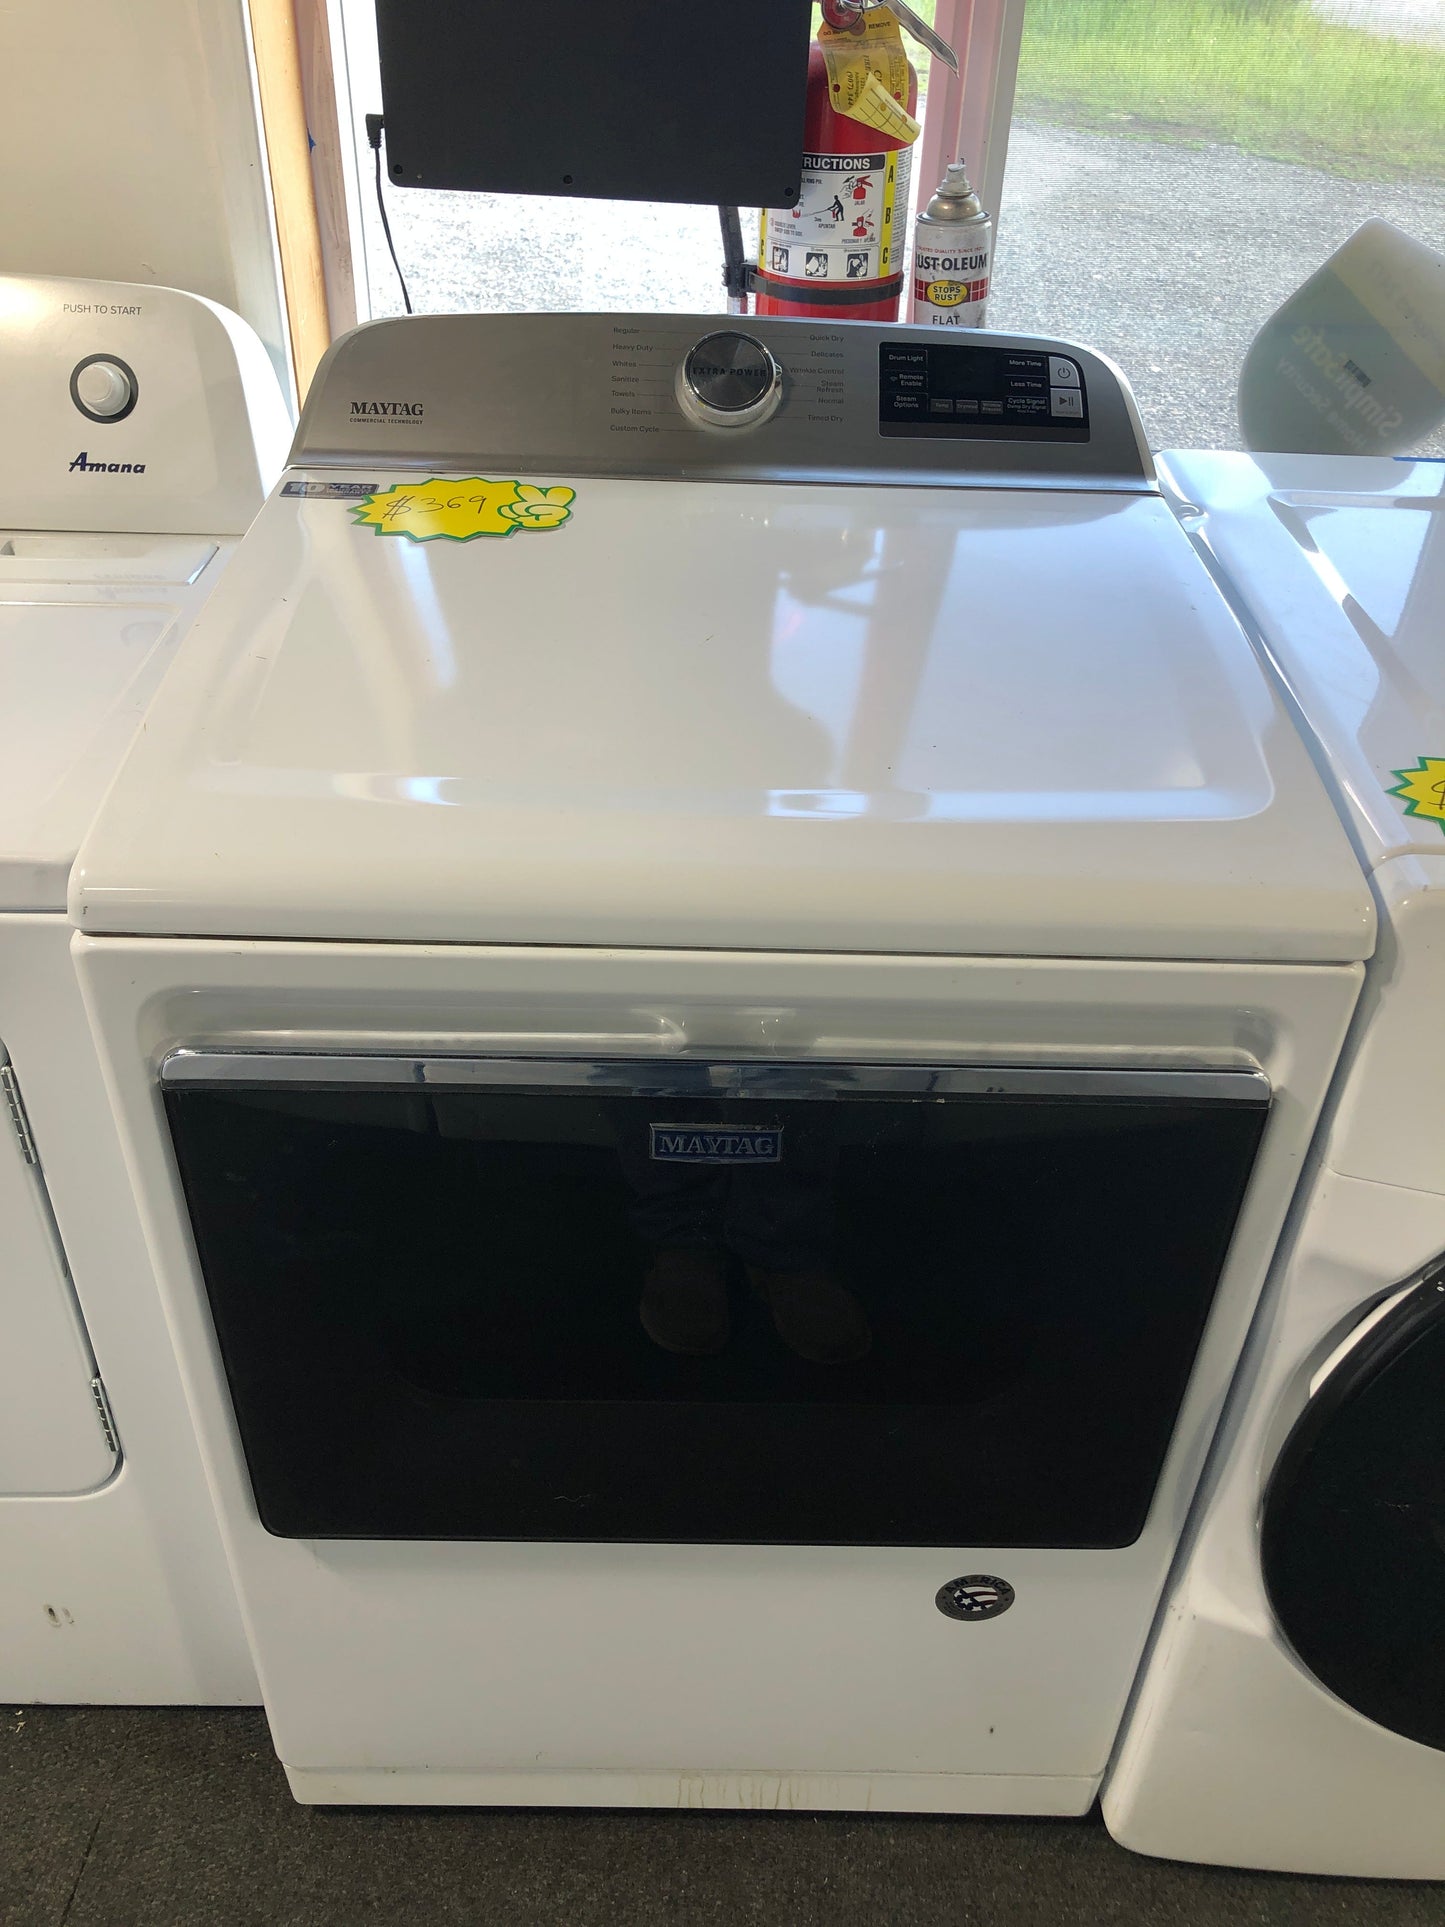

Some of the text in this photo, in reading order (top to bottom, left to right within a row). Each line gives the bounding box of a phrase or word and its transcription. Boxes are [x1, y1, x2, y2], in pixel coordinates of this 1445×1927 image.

[868, 21, 891, 30] REMOVE
[802, 156, 871, 170] RUCTIONS
[933, 285, 960, 294] STOPS
[934, 293, 958, 301] RUST
[63, 304, 142, 316] PUSH TO START
[932, 315, 960, 325] FLAT
[613, 327, 640, 335] Regular
[831, 335, 844, 343] Dry
[612, 344, 635, 352] Heavy
[811, 350, 844, 358] Delicates
[692, 367, 767, 377] EXTRA POWER
[817, 367, 844, 375] Control
[611, 375, 639, 383] Sanitize
[821, 379, 844, 387] Steam
[818, 397, 844, 405] Normal
[893, 401, 919, 409] Options
[350, 401, 424, 416] MAYTAG
[610, 407, 630, 415] Bulky
[808, 414, 843, 423] Timed Dry
[610, 424, 660, 433] Custom Cycle
[68, 451, 146, 474] Amana
[289, 482, 326, 493] 10
[659, 1134, 775, 1155] MAYTAG
